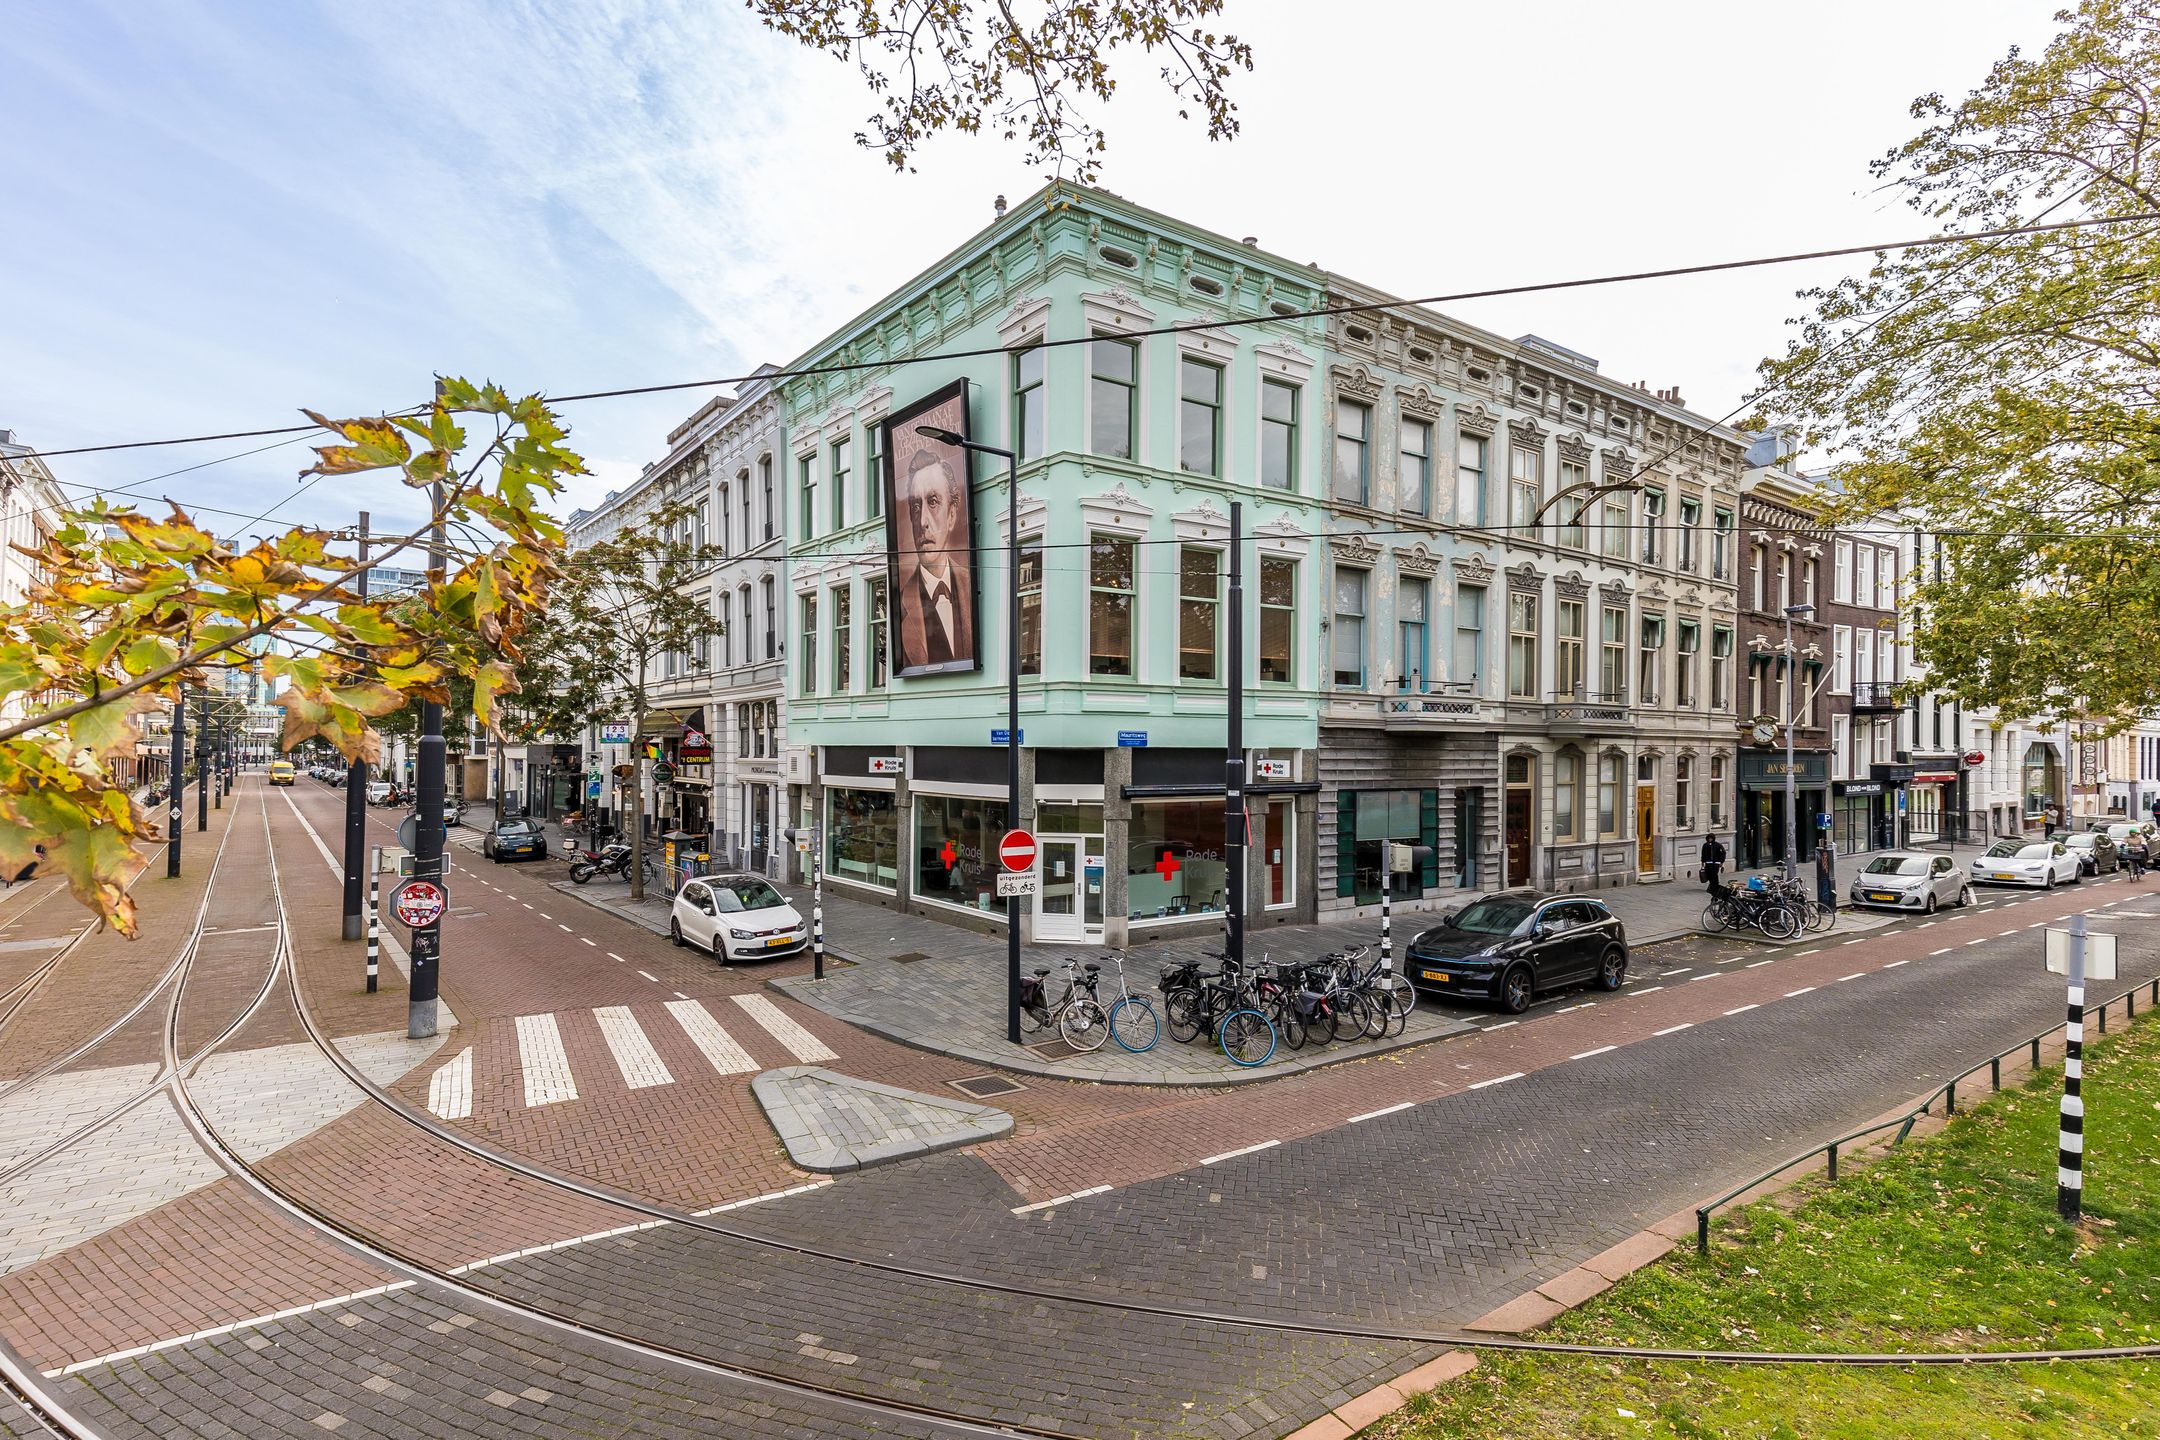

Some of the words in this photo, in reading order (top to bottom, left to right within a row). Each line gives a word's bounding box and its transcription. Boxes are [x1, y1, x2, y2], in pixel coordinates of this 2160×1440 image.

[1766, 764, 1778, 773] JAN
[960, 844, 982, 859] Rode
[1186, 849, 1217, 861] Rode
[960, 860, 981, 875] Kruis
